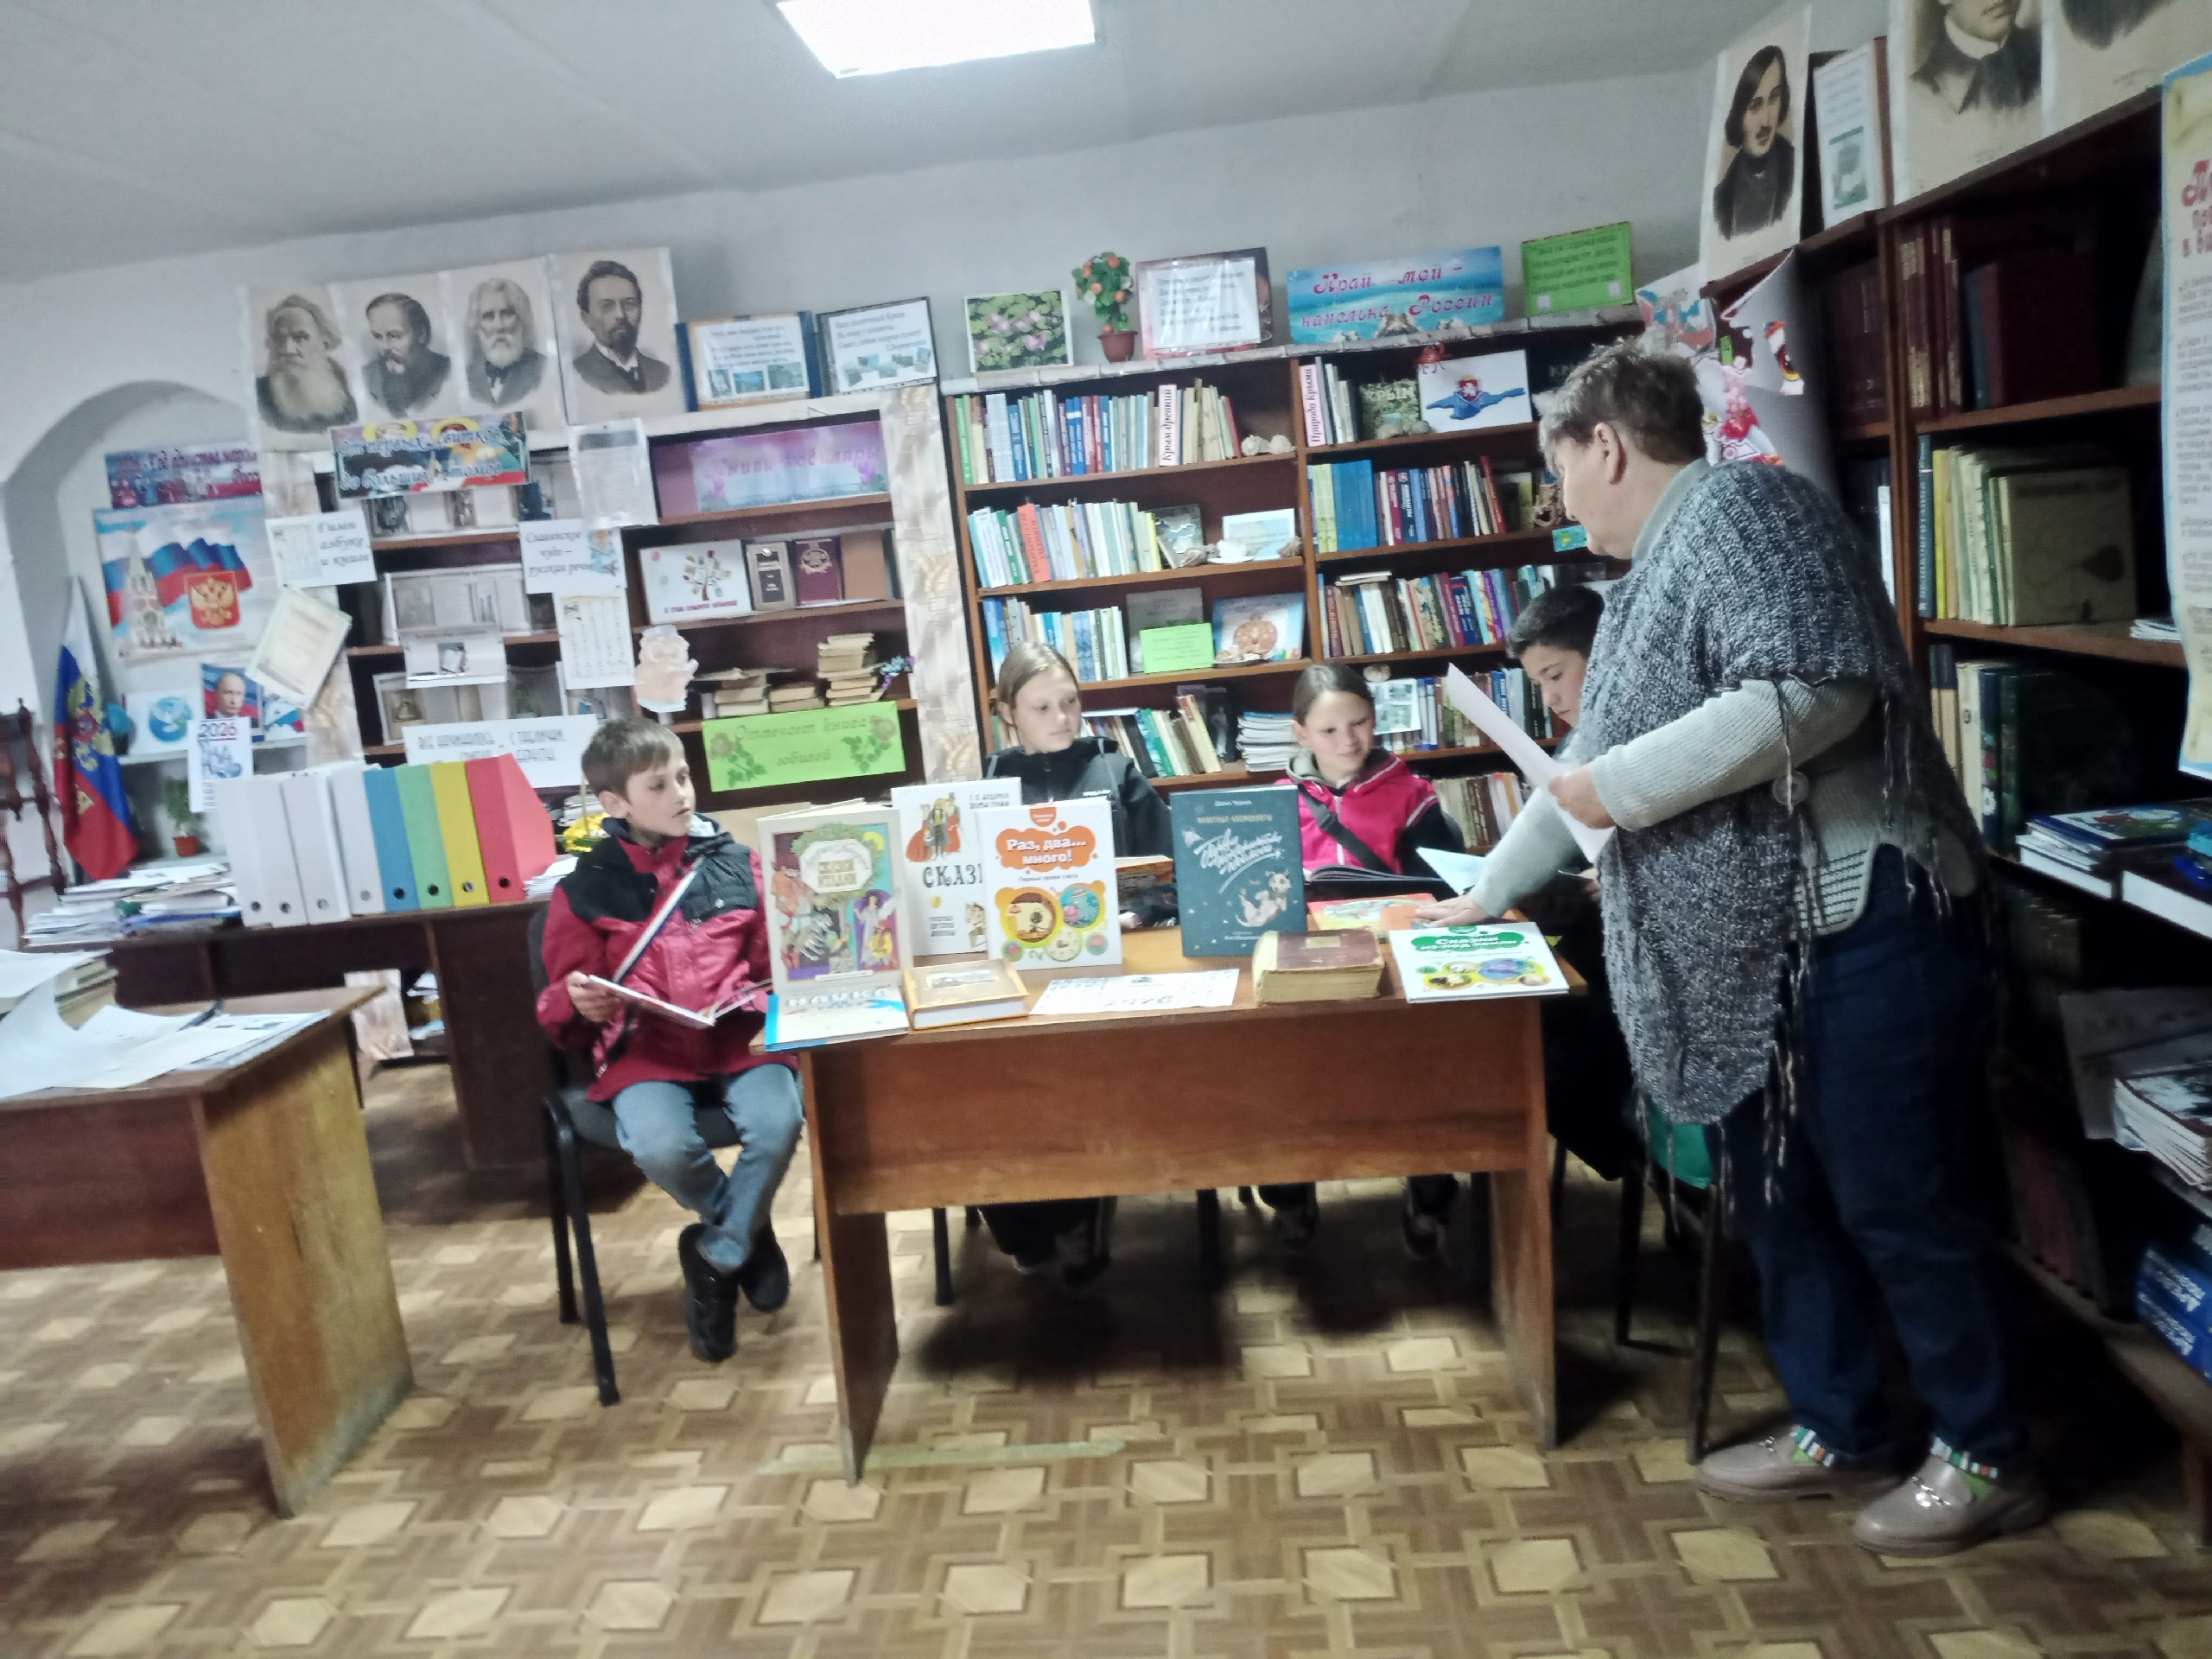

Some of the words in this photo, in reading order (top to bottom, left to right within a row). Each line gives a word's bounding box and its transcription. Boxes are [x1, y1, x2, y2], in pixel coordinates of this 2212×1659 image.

[1313, 272, 1372, 299] Край
[1398, 267, 1442, 285] мой
[1301, 306, 1389, 328] капелька
[1408, 294, 1493, 317] России
[1305, 369, 1318, 401] Крыма
[1161, 389, 1175, 430] древний
[1306, 403, 1323, 442] Природа
[1161, 432, 1175, 461] Крым
[735, 723, 816, 741] Отмечает
[1007, 839, 1040, 851] Раз,
[1023, 849, 1073, 865] много!
